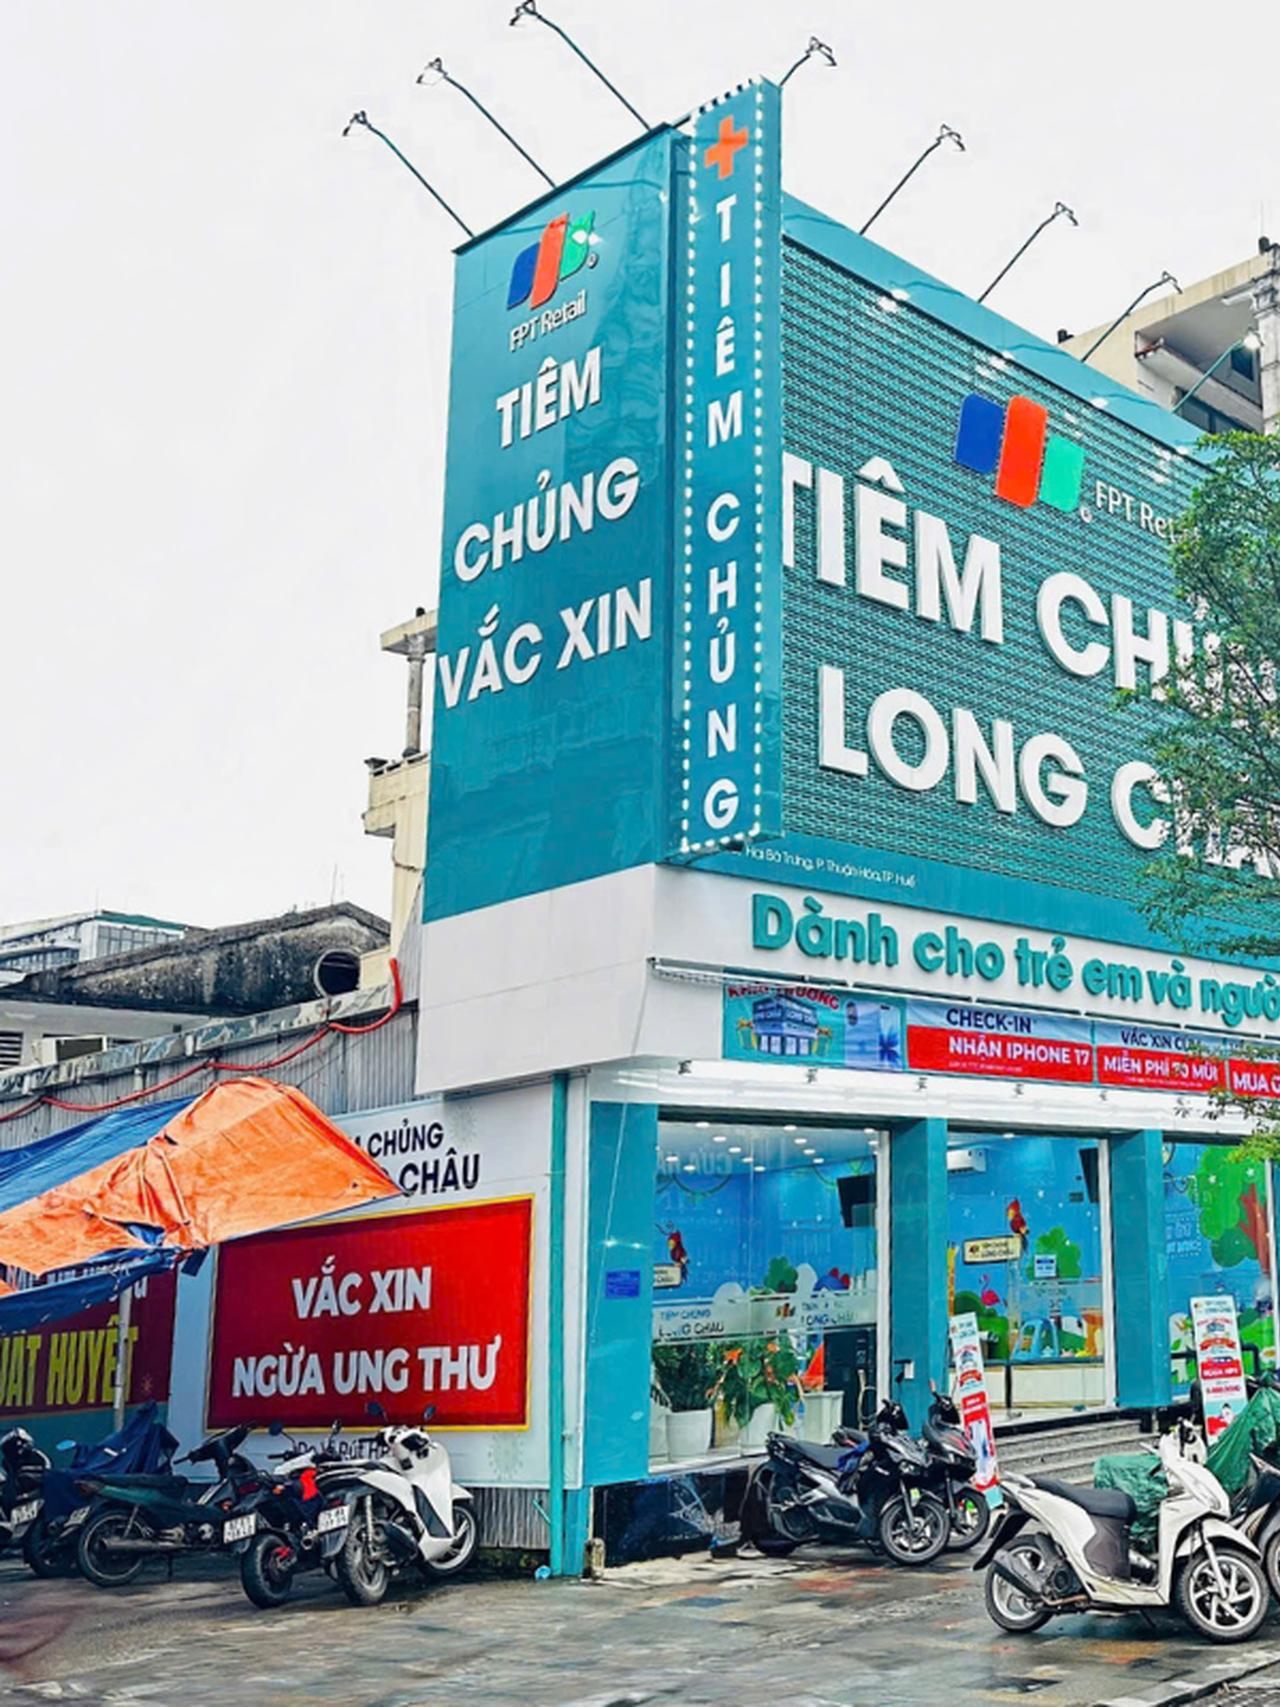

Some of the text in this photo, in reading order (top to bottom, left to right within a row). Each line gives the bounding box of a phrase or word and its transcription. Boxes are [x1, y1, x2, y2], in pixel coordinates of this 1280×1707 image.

[508, 288, 587, 354] FPT Retail
[495, 346, 602, 450] TIÊM
[454, 456, 641, 583] CHỦNG
[703, 194, 743, 830] TIÊM CHỦNG
[1095, 479, 1136, 523] FPT
[437, 577, 653, 709] VẮC XIN
[818, 664, 1089, 829] LONG
[753, 893, 899, 967] Dành
[913, 925, 1005, 981] cho
[1015, 936, 1074, 992] trẻ
[1082, 958, 1144, 1003] em
[1147, 959, 1193, 1010] và
[946, 1008, 1032, 1034] CHECK-IN
[949, 1034, 1090, 1066] NHẬN IPHONE 17
[1151, 1033, 1173, 1048] XIN
[1103, 1050, 1142, 1074] MIỄN
[1144, 1059, 1170, 1077] PHÍ
[1233, 1072, 1269, 1092] MUA
[367, 1117, 445, 1159] CHỦNG
[399, 1147, 480, 1198] CHÂU
[291, 1255, 432, 1319] VẮC XIN
[232, 1335, 503, 1399] NGỪA UNG THƯ
